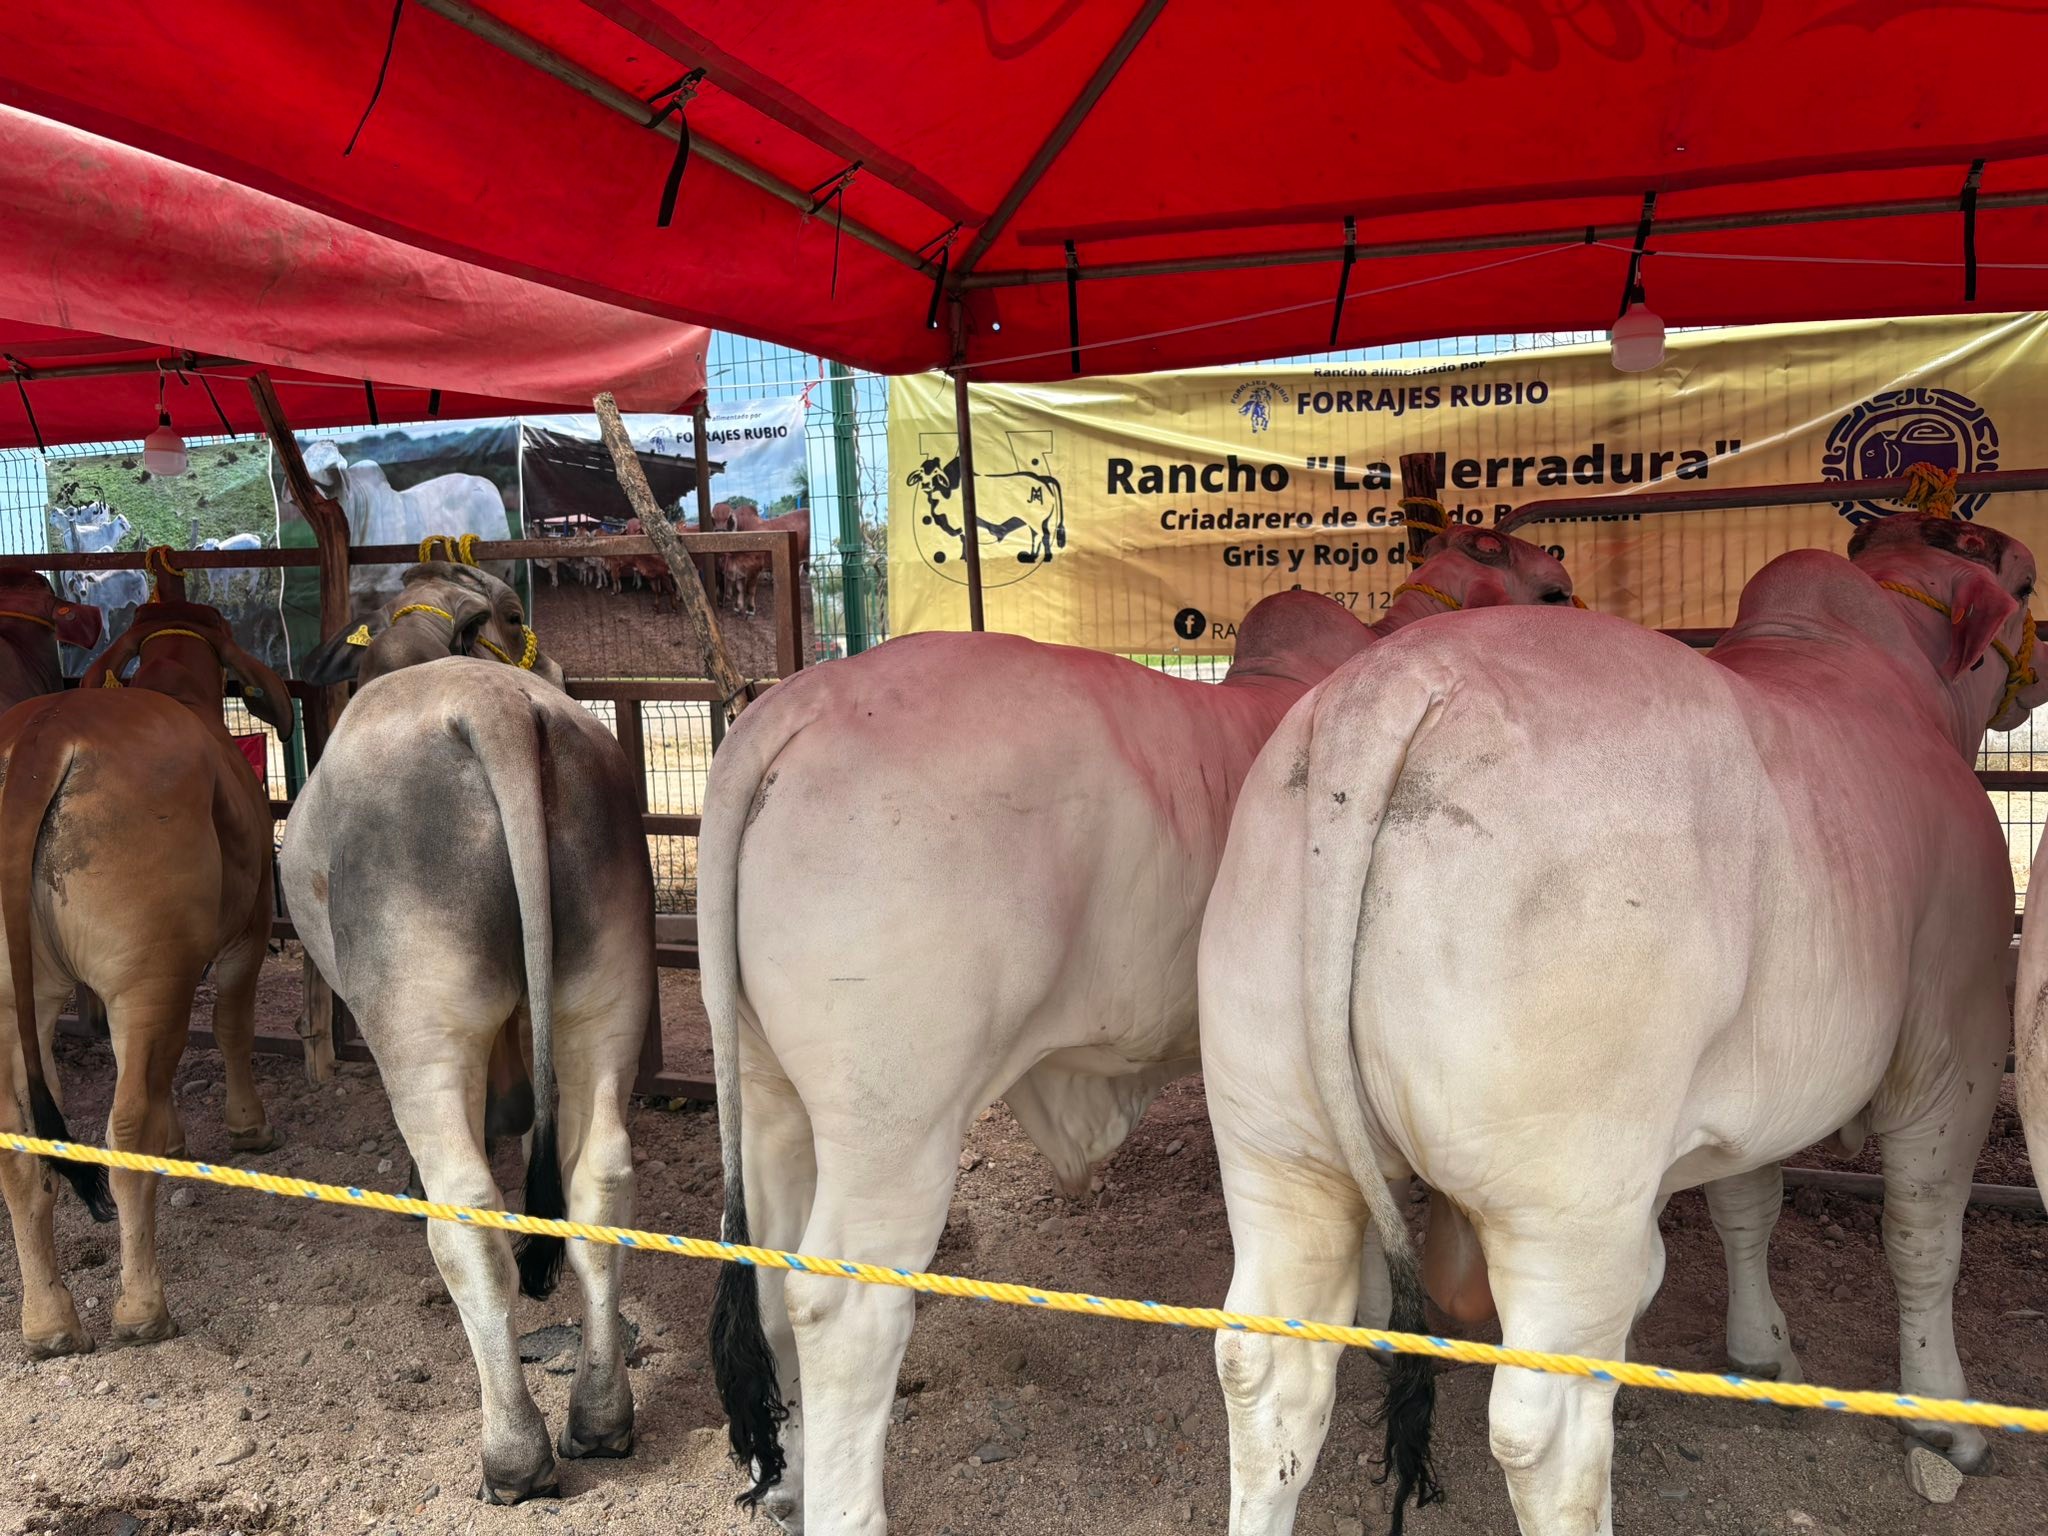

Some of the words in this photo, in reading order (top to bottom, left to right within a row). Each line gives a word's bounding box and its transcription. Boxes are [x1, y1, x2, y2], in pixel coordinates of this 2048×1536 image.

[1313, 367, 1367, 379] Rancho
[1371, 362, 1456, 378] alimentado
[1460, 360, 1487, 373] por
[1231, 380, 1267, 404] FORRAJES
[1268, 382, 1290, 403] RUBIO
[1296, 386, 1441, 417] FORRAJES
[1450, 380, 1549, 408] RUBIO
[676, 428, 741, 445] FORAJES
[744, 425, 788, 440] RUBIO
[1107, 454, 1290, 496] Rancho
[1305, 455, 1392, 491] "La
[1160, 507, 1314, 531] Criadarero
[1322, 506, 1358, 528] de
[1222, 544, 1280, 567] Gris
[1287, 549, 1306, 573] y
[1313, 542, 1379, 572] Rojo
